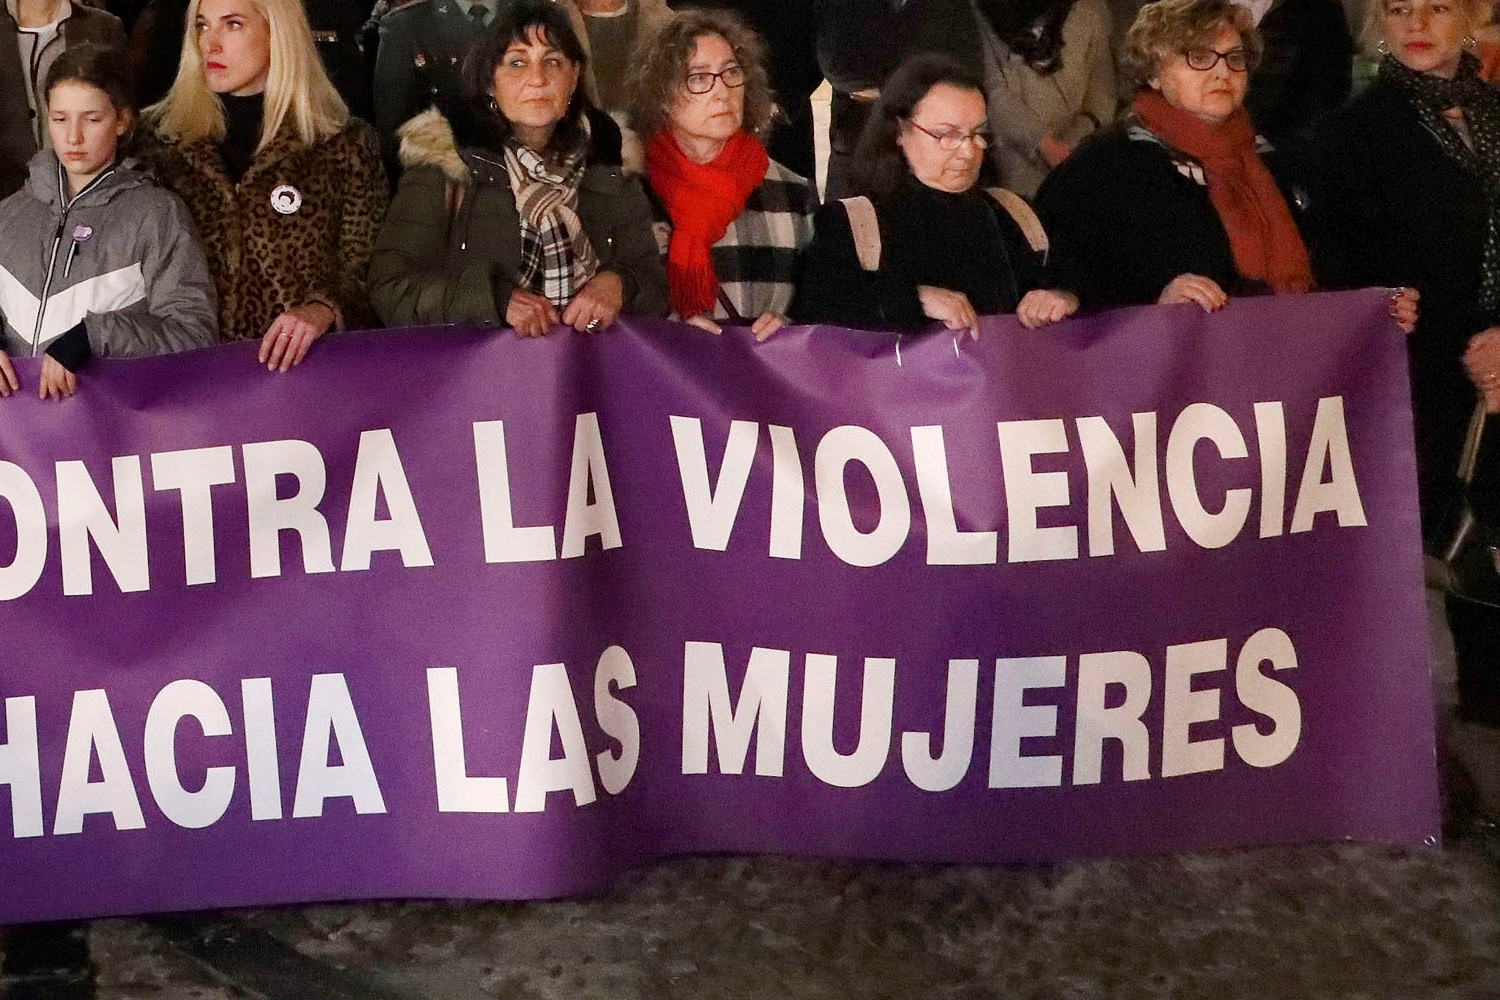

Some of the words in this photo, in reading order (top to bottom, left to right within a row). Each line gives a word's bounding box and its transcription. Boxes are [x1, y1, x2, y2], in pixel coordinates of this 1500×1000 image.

[472, 412, 624, 564] LA
[669, 396, 1368, 568] VIOLENCIA
[426, 645, 640, 814] LAS
[681, 627, 1302, 792] MUJERES
